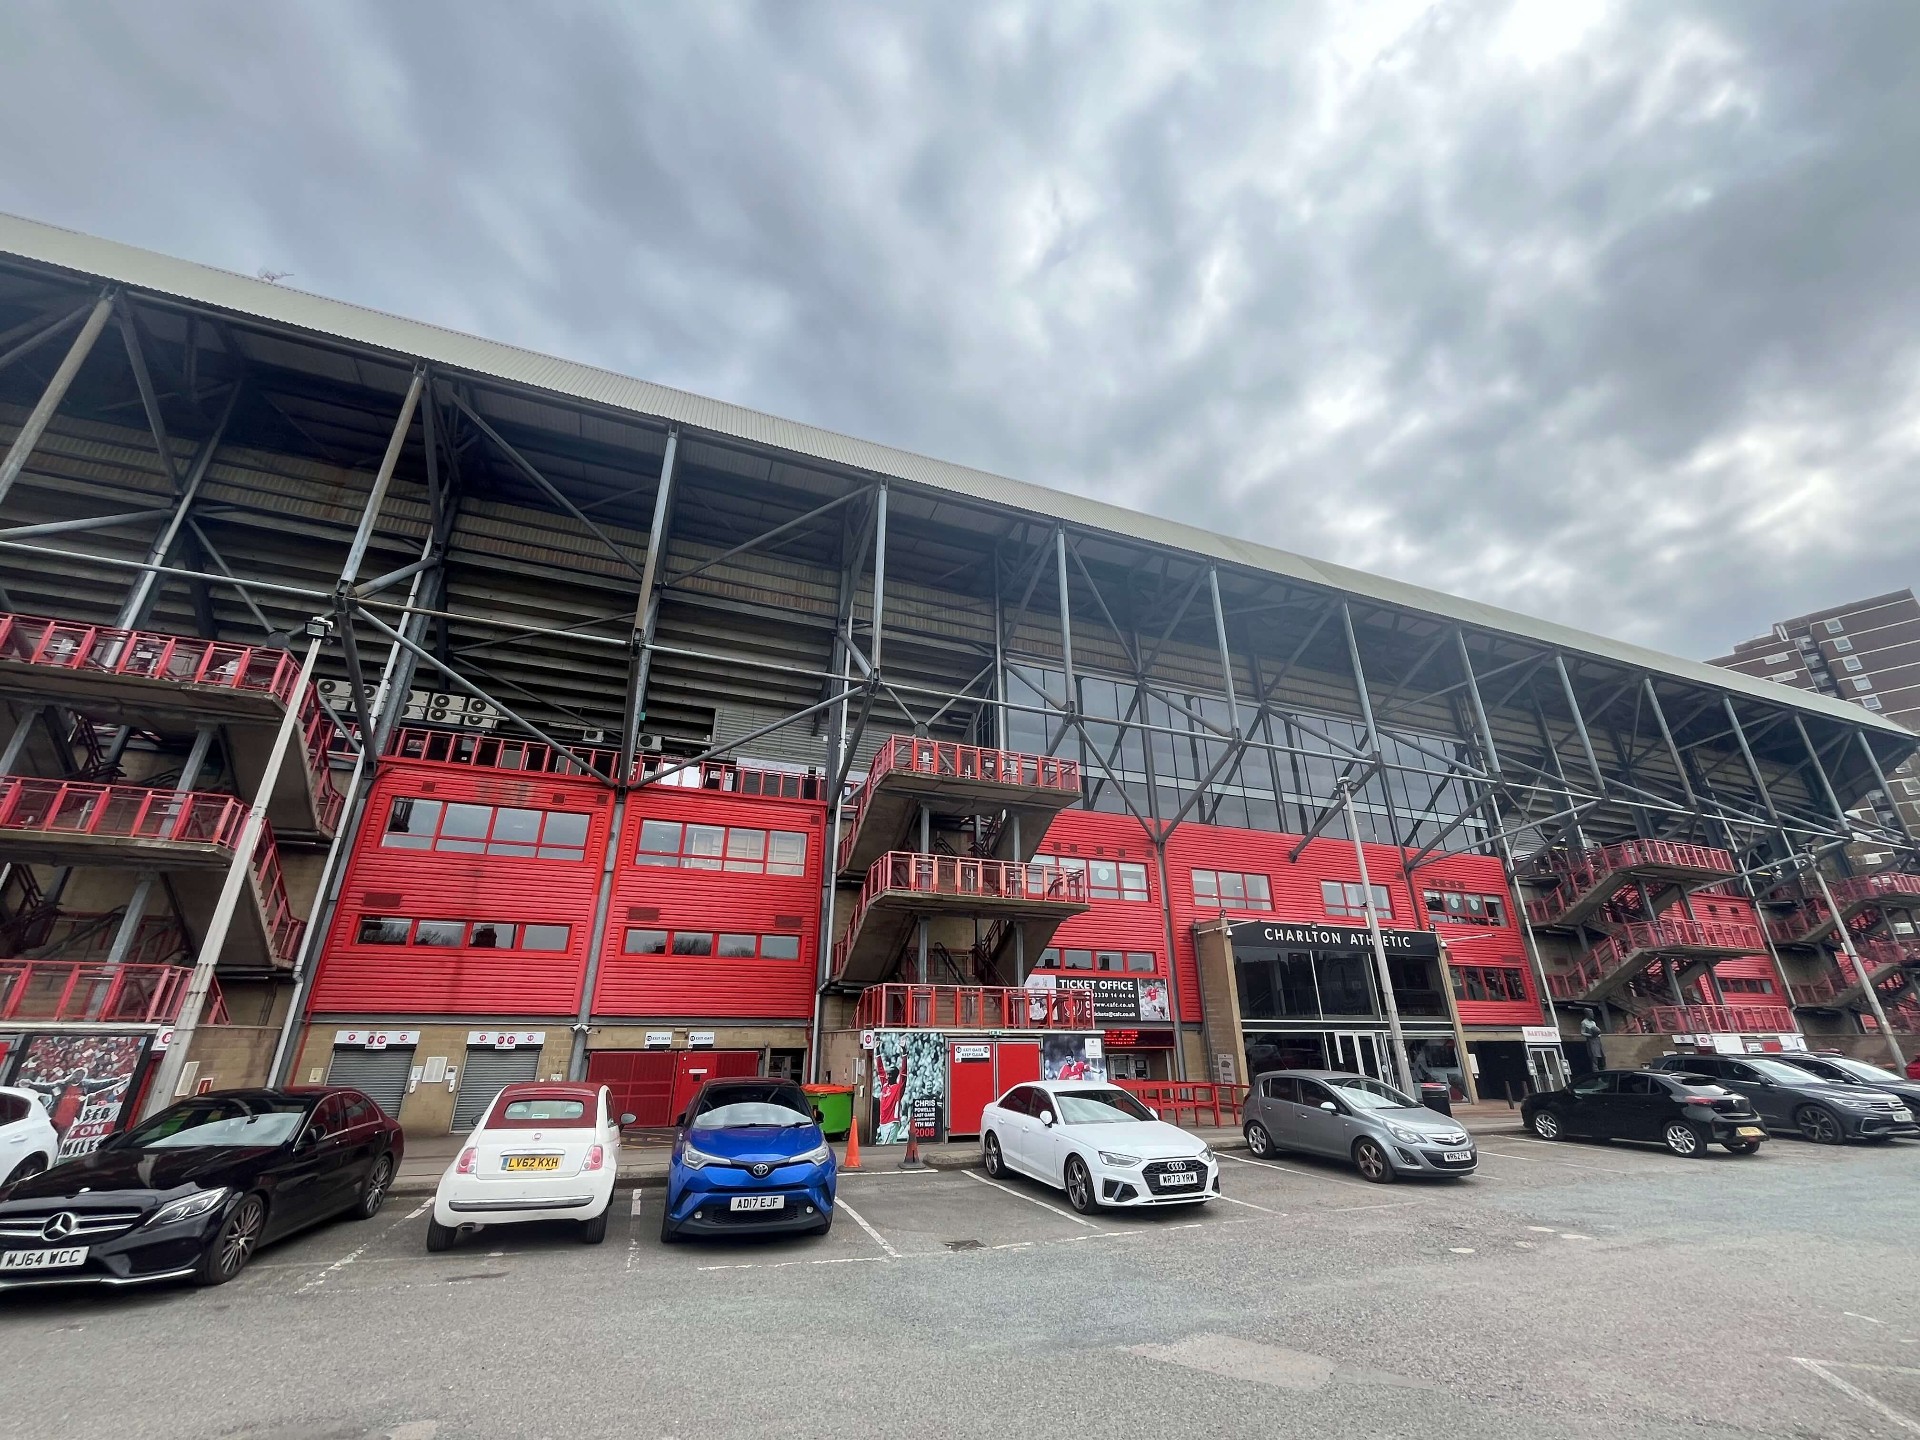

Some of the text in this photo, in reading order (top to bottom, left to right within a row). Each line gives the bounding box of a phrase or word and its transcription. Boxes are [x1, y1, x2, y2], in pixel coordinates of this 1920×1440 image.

[1264, 928, 1411, 948] CHARLTON ATHETIC
[1059, 979, 1134, 990] TICKET OFFICE
[914, 1099, 936, 1107] CHRIS
[914, 1127, 935, 1137] 2008
[508, 1157, 558, 1168] LV62 KXH
[736, 1197, 778, 1209] AD17 EJF
[5, 1249, 80, 1267] MJ64 WCC
